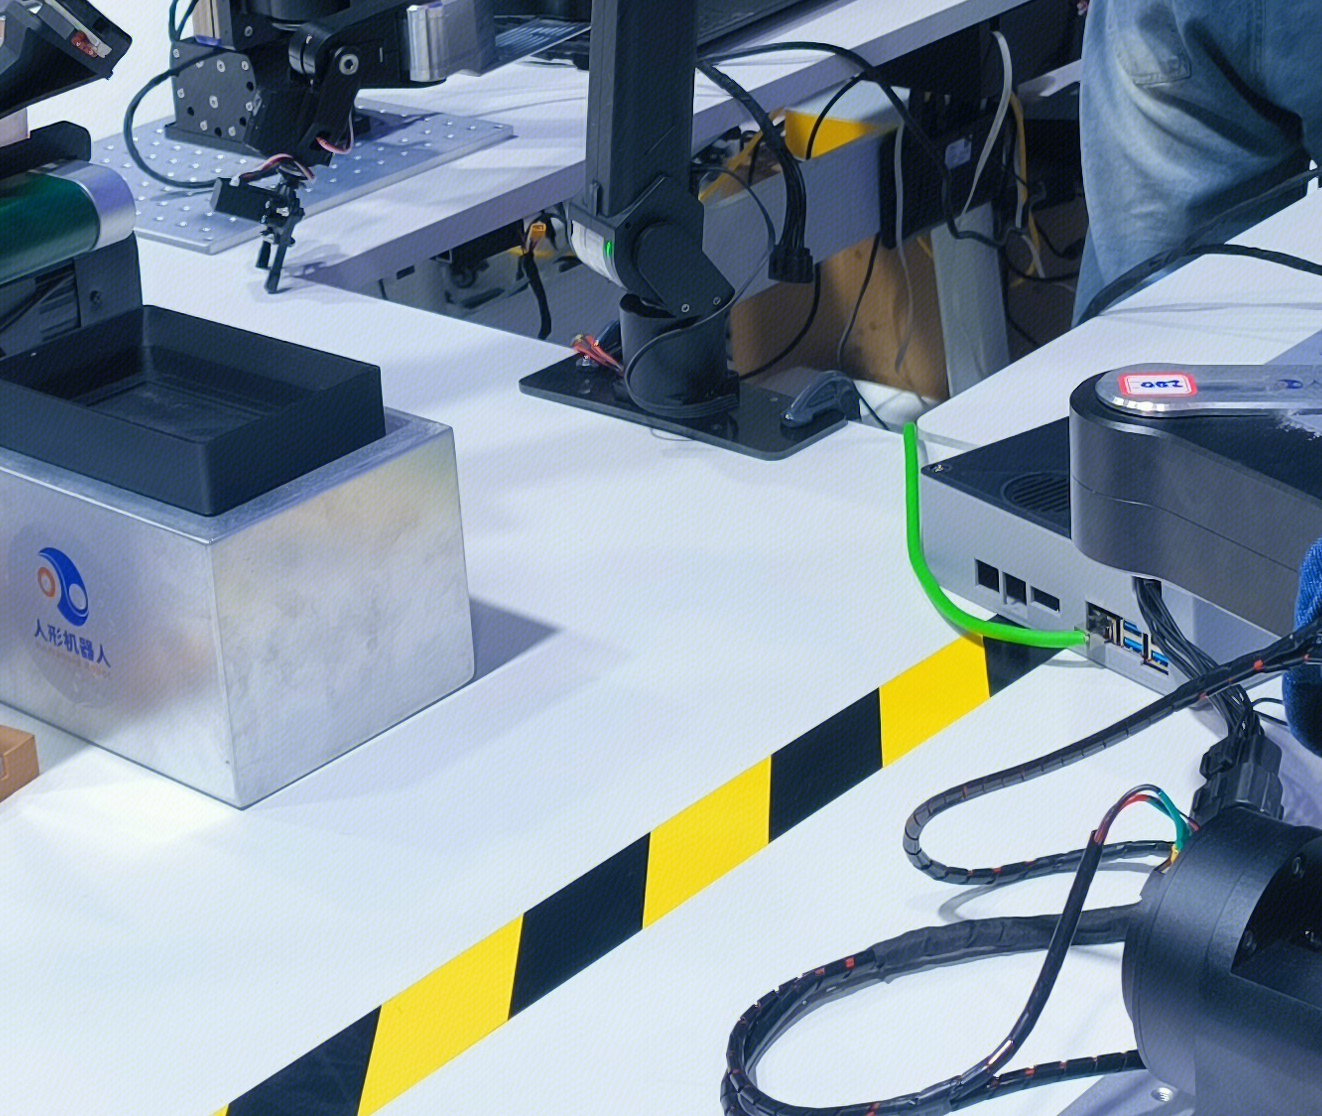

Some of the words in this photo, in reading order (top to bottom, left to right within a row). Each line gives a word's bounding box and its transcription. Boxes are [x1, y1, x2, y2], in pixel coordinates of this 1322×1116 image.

[34, 618, 112, 668] 人形机器人
